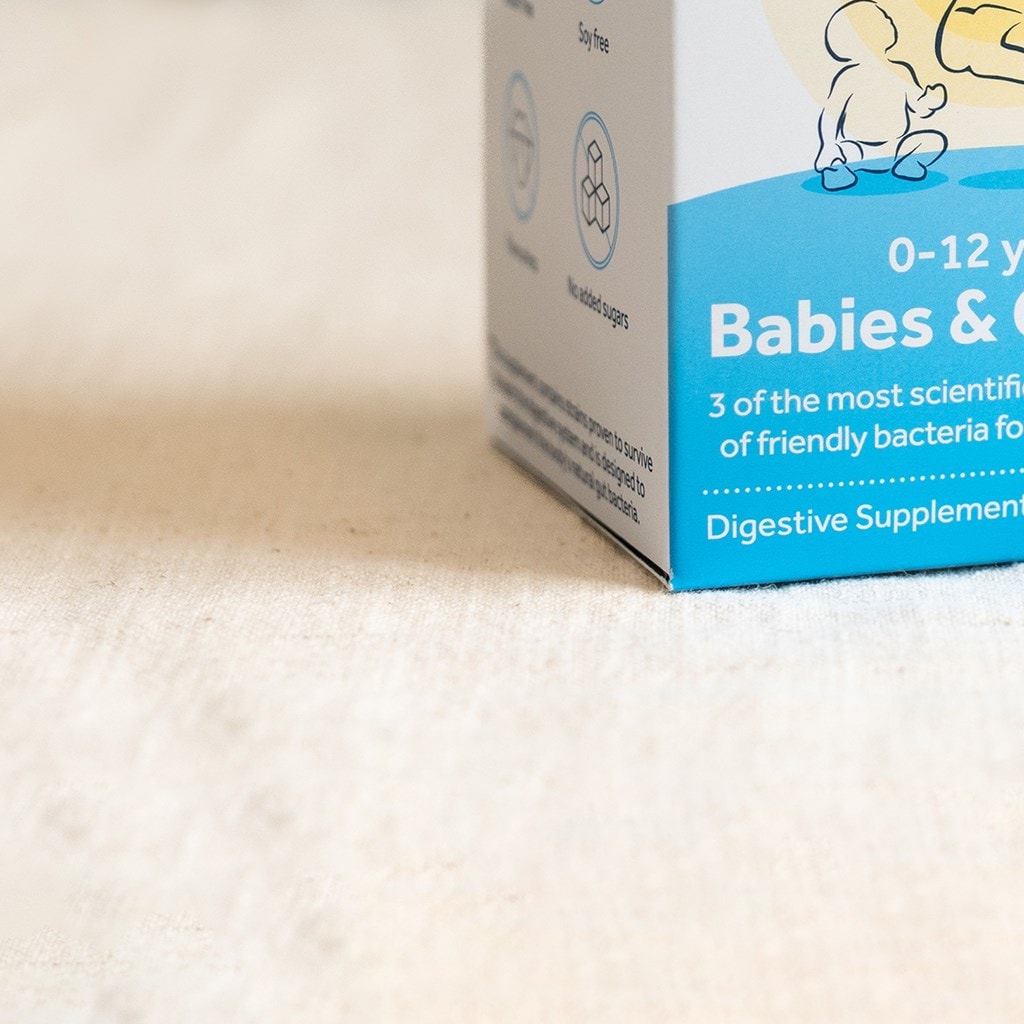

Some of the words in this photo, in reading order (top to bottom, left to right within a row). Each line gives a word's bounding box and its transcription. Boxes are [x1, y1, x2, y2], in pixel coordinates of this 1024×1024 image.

[579, 22, 592, 53] Soy
[593, 28, 609, 54] free
[889, 233, 989, 273] 0-12
[602, 299, 629, 330] sugars
[711, 298, 933, 358] Babies
[949, 288, 998, 344] &
[709, 393, 726, 418] 3
[734, 389, 767, 416] of
[770, 389, 820, 414] the
[827, 384, 904, 411] most
[589, 417, 614, 446] proven
[624, 440, 653, 472] survive
[720, 431, 753, 458] of
[757, 425, 868, 458] friendly
[875, 418, 988, 449] bacteria
[602, 452, 635, 491] designed
[636, 475, 645, 498] to
[608, 483, 640, 525] bacteria.
[707, 509, 848, 545] Digestive
